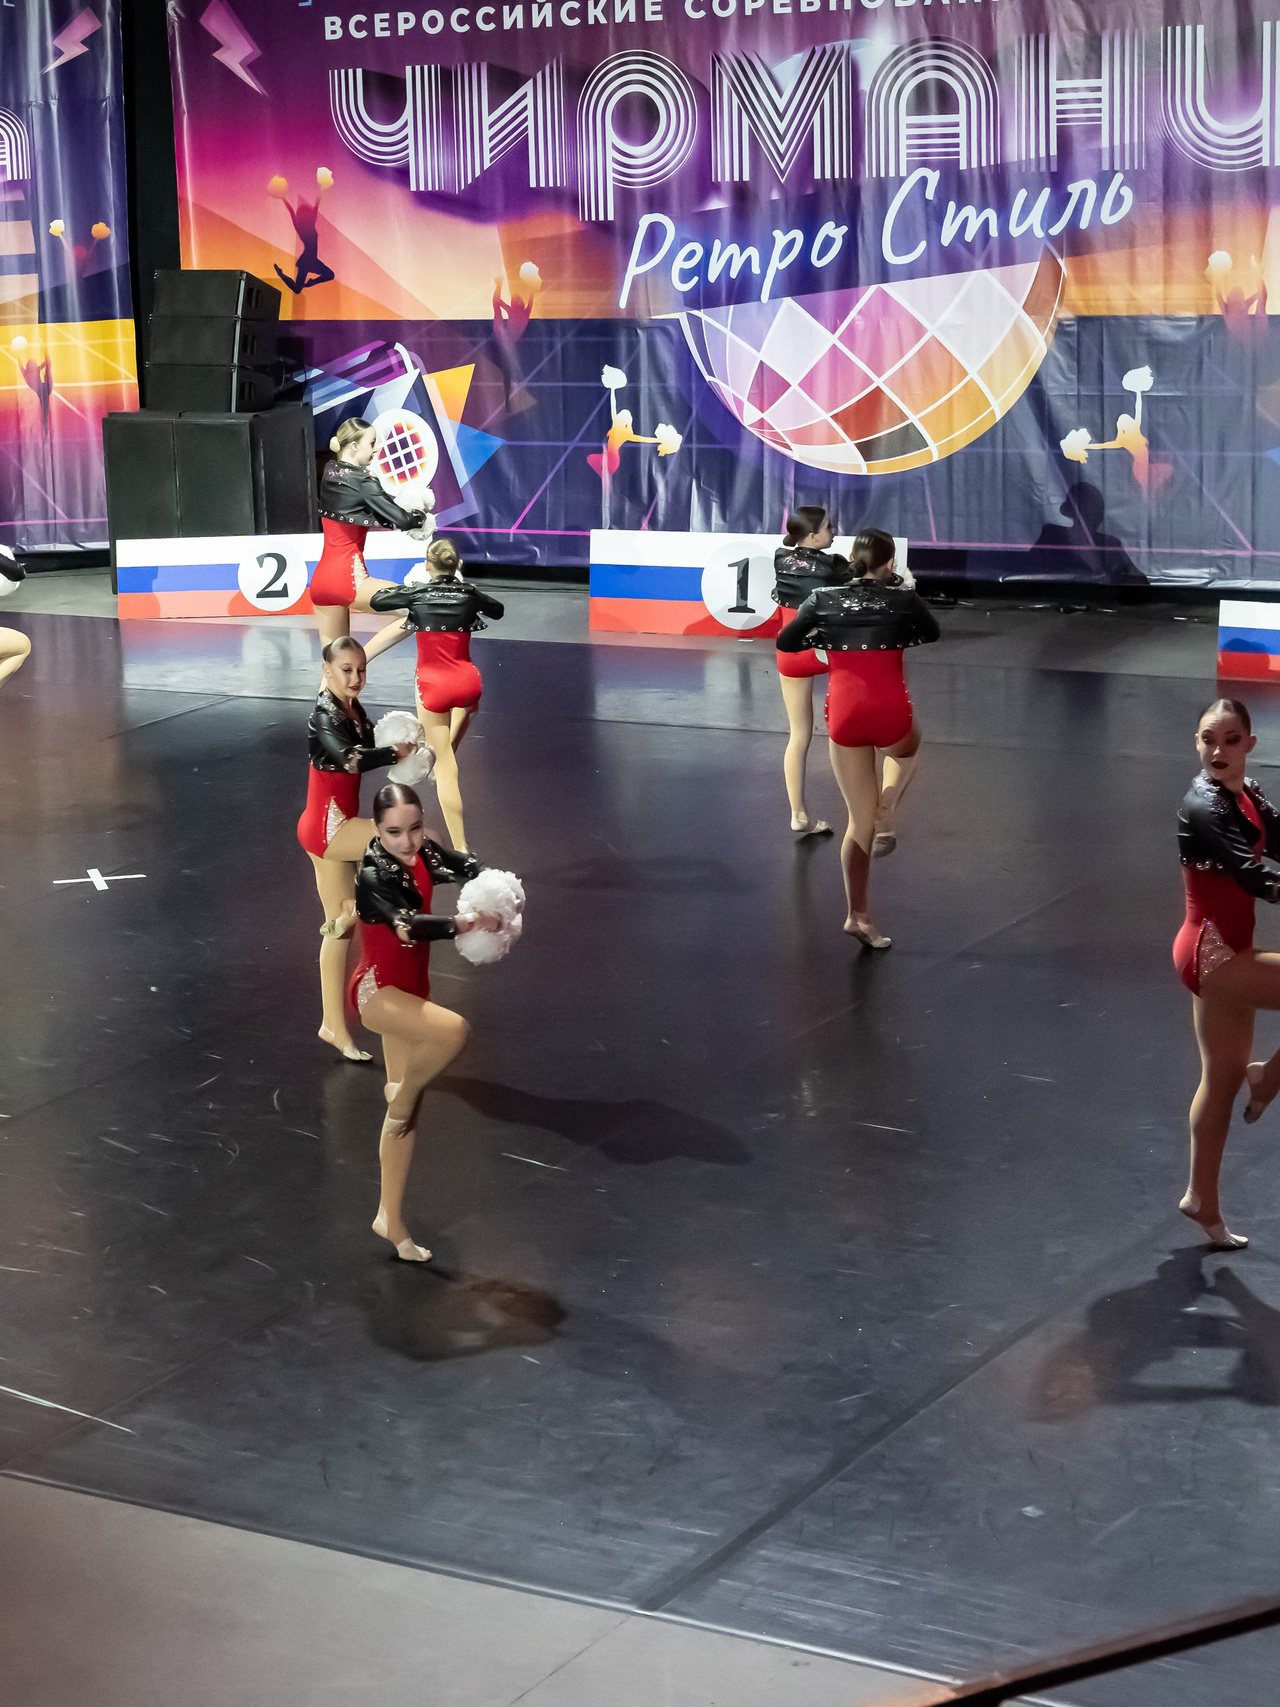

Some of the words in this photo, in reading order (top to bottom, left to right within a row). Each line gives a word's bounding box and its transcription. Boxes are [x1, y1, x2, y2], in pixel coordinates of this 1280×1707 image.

[324, 0, 664, 41] ВСЕРОССИЙСКИЕ
[618, 212, 850, 310] Ретро
[880, 167, 1134, 266] Стиль
[255, 552, 290, 599] 2
[727, 557, 757, 614] 1
